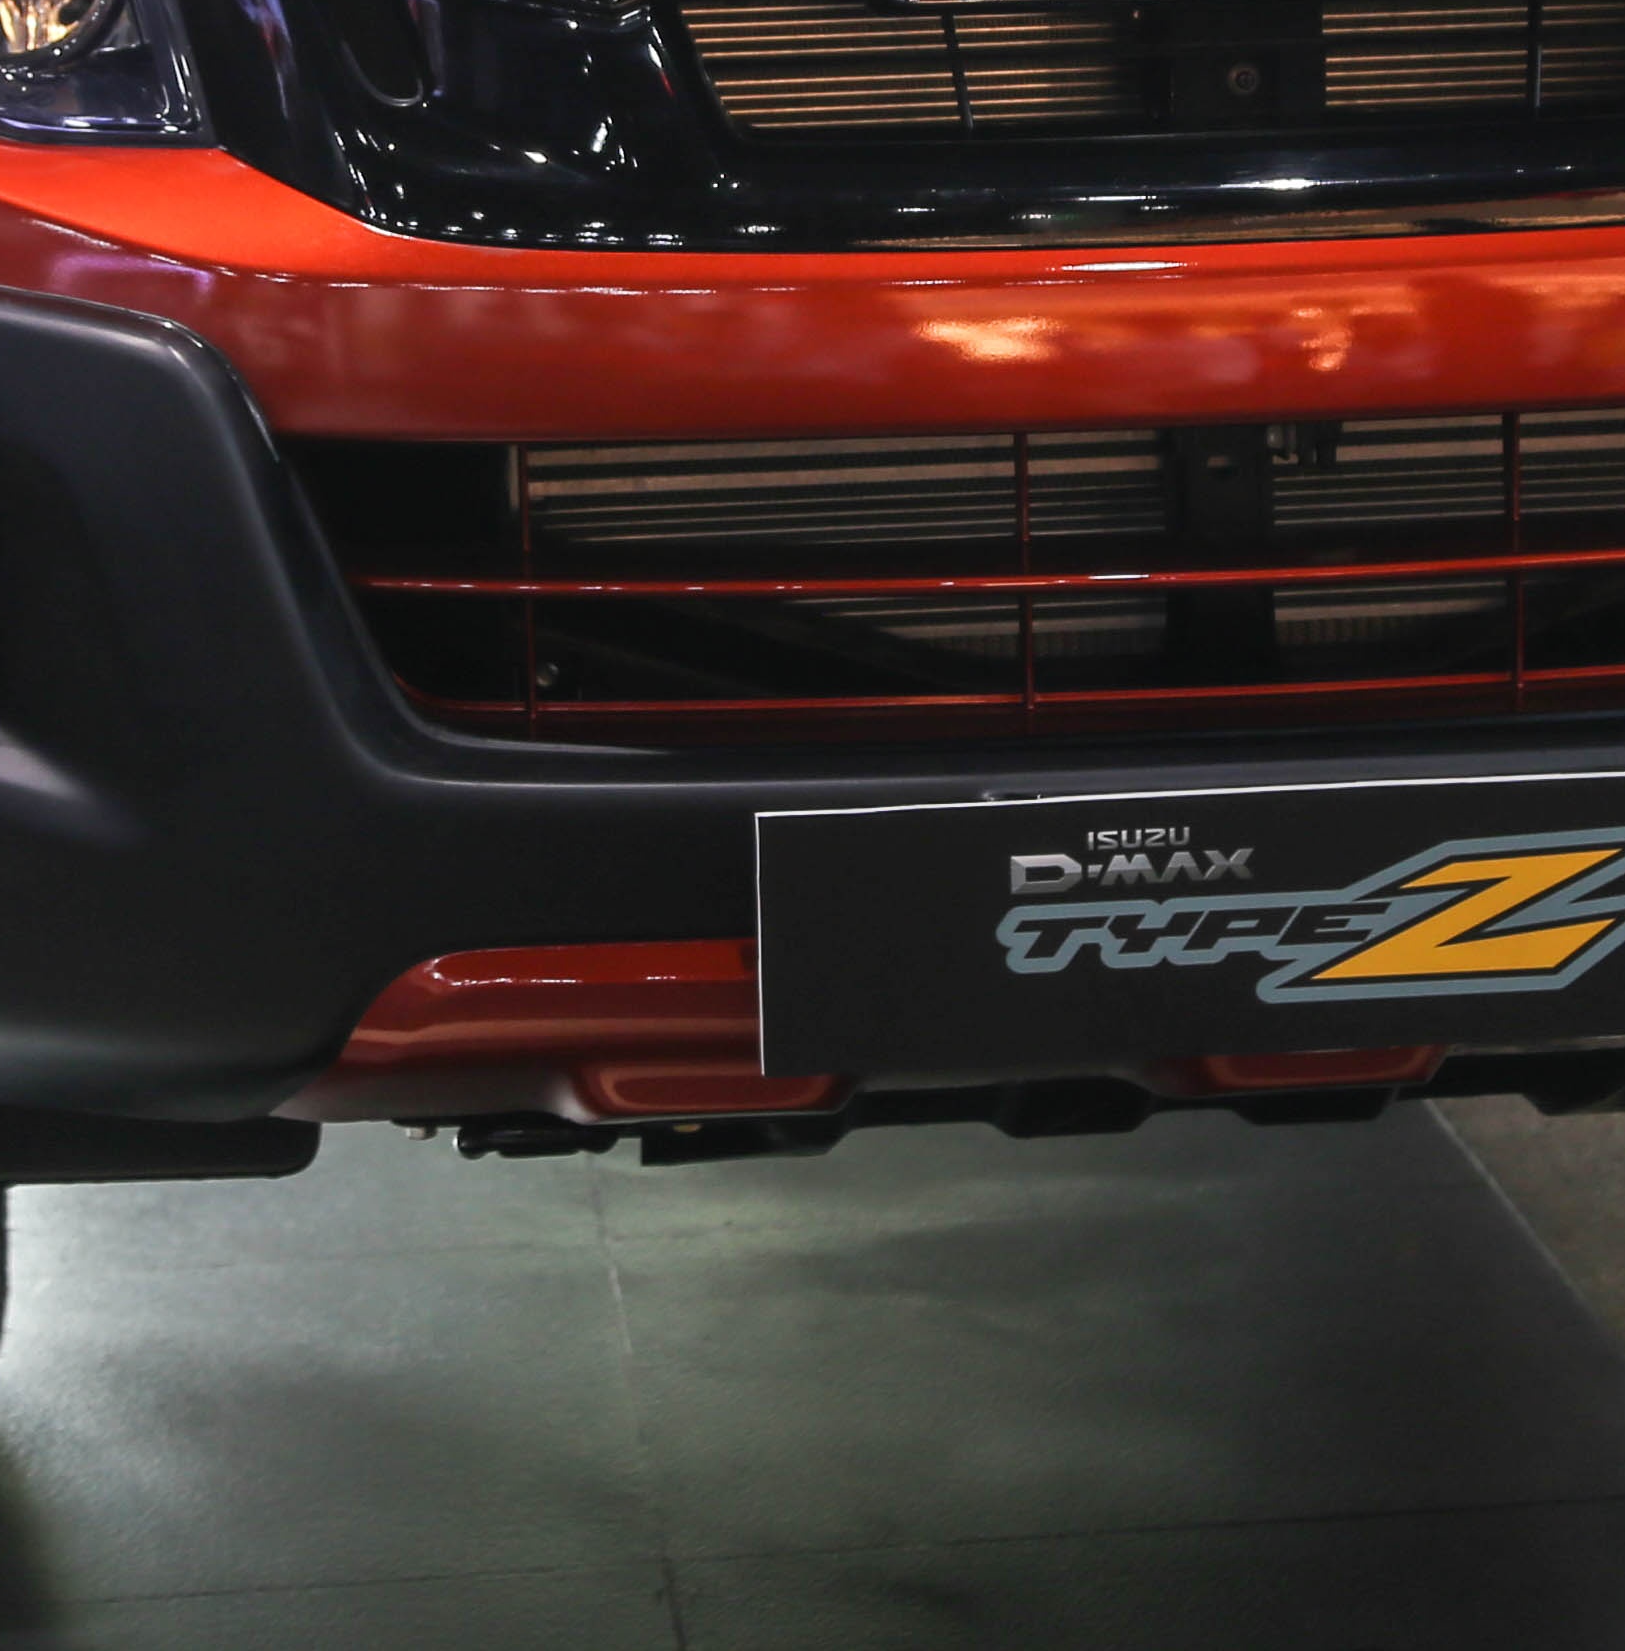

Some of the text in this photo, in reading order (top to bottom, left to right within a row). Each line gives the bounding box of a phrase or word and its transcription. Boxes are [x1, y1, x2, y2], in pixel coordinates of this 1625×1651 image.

[1087, 826, 1191, 849] ISUZU
[1010, 848, 1255, 894] D-MAX
[1008, 898, 1393, 964] TYPE
